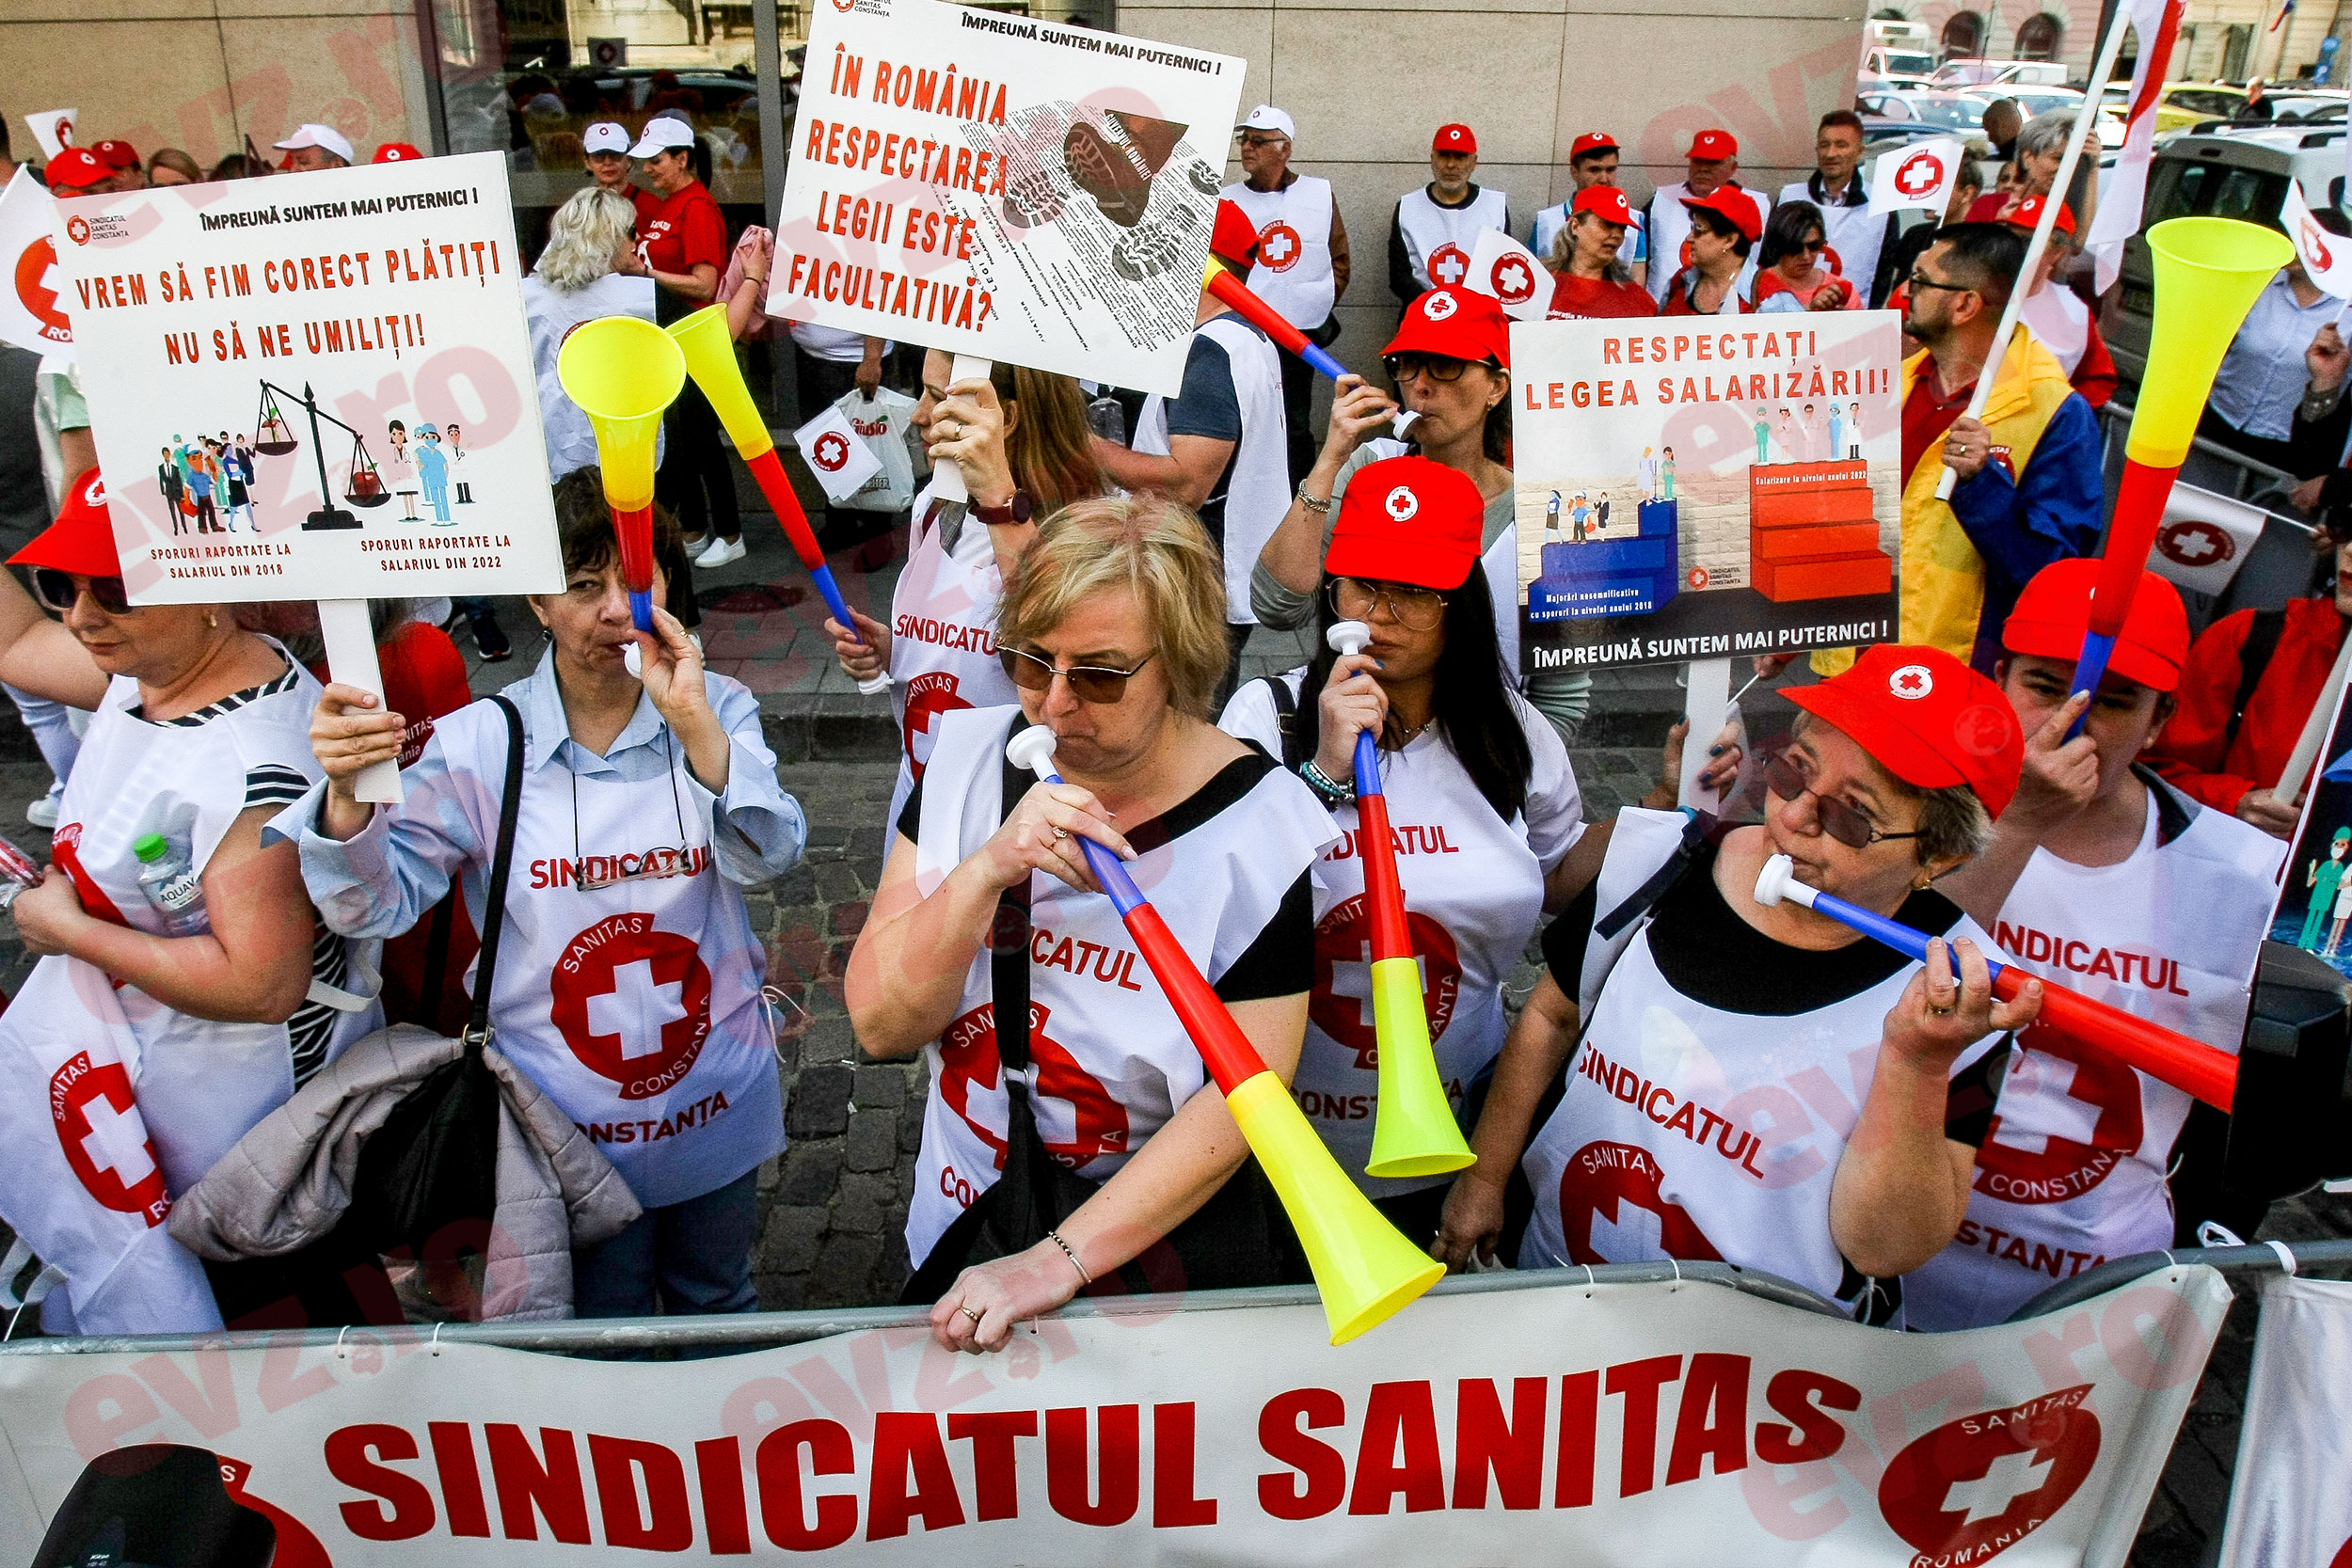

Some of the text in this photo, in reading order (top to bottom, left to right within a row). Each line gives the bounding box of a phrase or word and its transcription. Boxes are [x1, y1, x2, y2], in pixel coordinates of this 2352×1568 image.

[961, 11, 1038, 40] ÎMPREUNĂ
[1041, 30, 1103, 53] SUNTEM
[1104, 40, 1134, 57] MAI
[1136, 47, 1212, 74] PUTERNICI
[831, 43, 1007, 126] ÎN ROMÂNIA
[1104, 113, 1132, 150] GUVERNUL
[806, 119, 1008, 198] RESPECTAREA
[89, 215, 126, 225] SINDICATUL
[91, 224, 118, 232] SANITAS
[200, 206, 281, 231] ÎMPREUNĂ
[283, 201, 346, 223] SUNTEM
[351, 197, 382, 214] MAI
[387, 189, 469, 214] PUTERNICI
[817, 191, 893, 244] LEGII
[904, 208, 976, 261] ESTE
[75, 239, 501, 309] VREM SĂ FIM CORECT PLĂTIȚI
[788, 255, 992, 332] FACULTATIVĂ?
[164, 313, 425, 365] NU SĂ NE UMILIȚI!
[1603, 330, 1816, 365] RESPECTAȚI
[1526, 366, 1889, 410] LEGEA SALARIZĂRII!
[1802, 473, 1825, 483] nivelul
[1827, 472, 1849, 482] anului
[1851, 470, 1867, 480] 2022
[151, 543, 291, 560] SPORURI RAPORTATE LA
[360, 534, 511, 553] SPORURI RAPORTATE LA
[380, 553, 501, 572] SALARIUL DIN 2022
[169, 562, 283, 579] SALARIUL DIN 2018
[1542, 609, 1569, 620] sporuri
[1572, 607, 1579, 616] la
[1581, 605, 1607, 614] nivelul
[1610, 603, 1632, 612] anului
[1634, 601, 1652, 610] 2018
[1580, 589, 1639, 602] nesemnificative
[894, 613, 999, 656] SINDICATU
[1533, 637, 1643, 669] ÎMPREUNĂ
[1647, 634, 1729, 658] SUNTEM
[1735, 631, 1773, 651] MAI
[1778, 622, 1877, 645] PUTERNICI
[398, 745, 421, 763] ania
[1317, 899, 1363, 934] SANIT
[564, 917, 644, 974] SANITAS
[53, 1057, 89, 1122] SANITAS
[1962, 1390, 2082, 1434] SANITAS
[324, 1353, 1862, 1555] SINDICATUL SANITAS
[1914, 1518, 2043, 1568] ROMANIA
